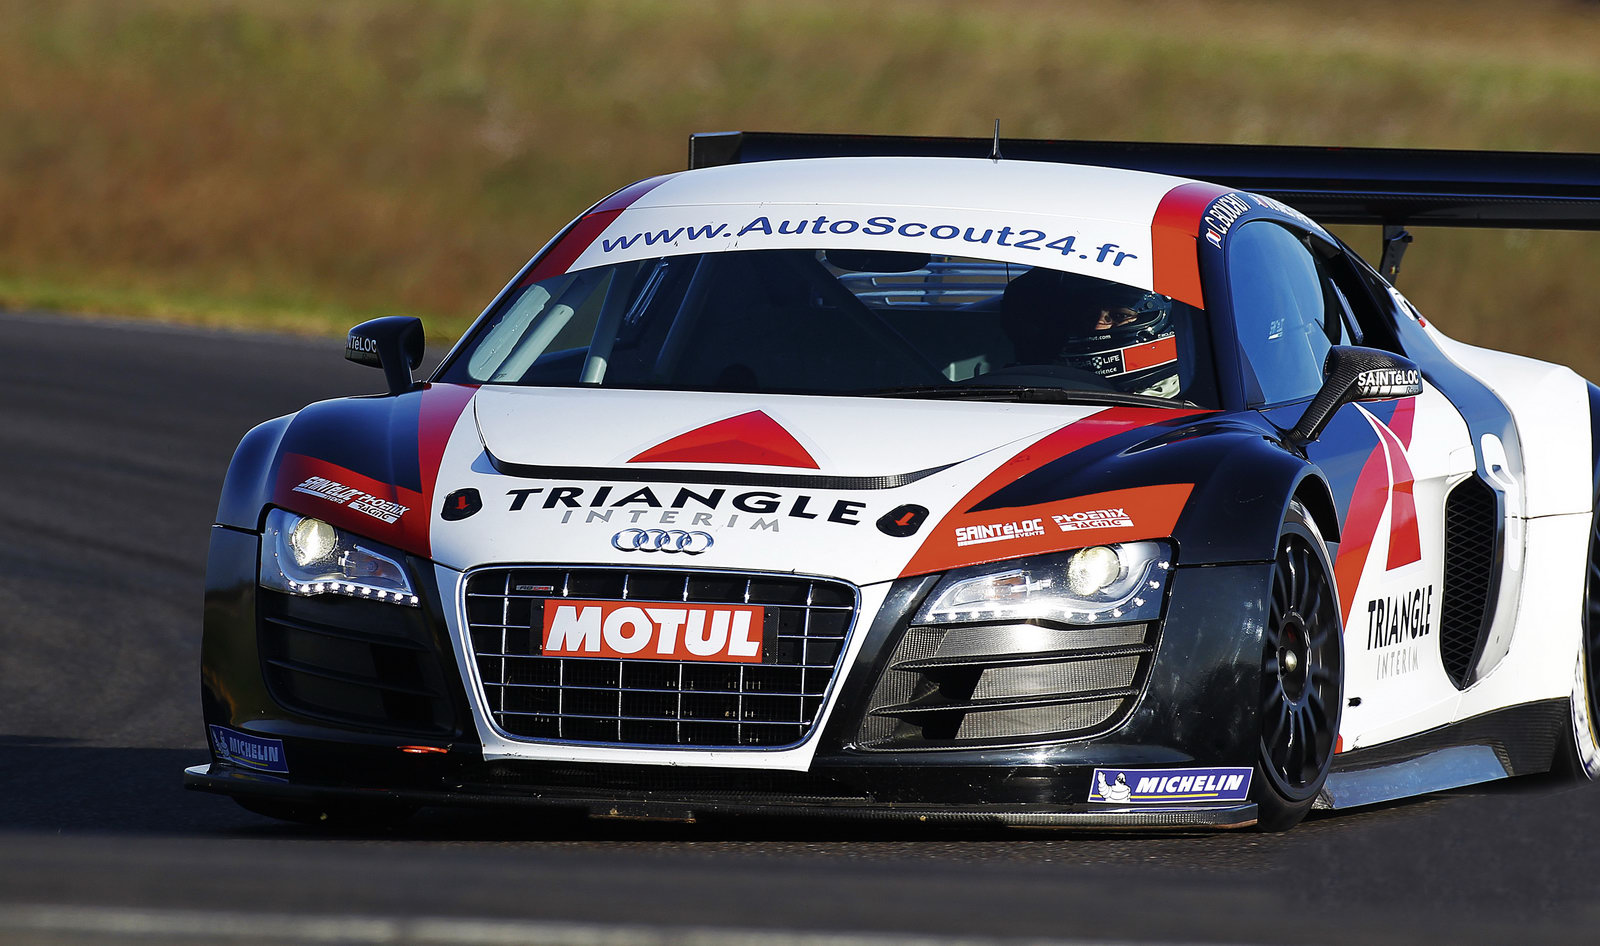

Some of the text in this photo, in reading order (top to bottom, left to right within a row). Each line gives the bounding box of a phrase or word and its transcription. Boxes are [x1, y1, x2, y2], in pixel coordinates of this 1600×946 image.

[602, 216, 1138, 268] www.AutoScout24.fr
[1102, 354, 1121, 365] LIFE
[1357, 369, 1419, 387] SAINTéLOC
[505, 485, 867, 526] TRIANGLE
[561, 509, 780, 533] INTERIM
[955, 518, 1044, 542] SAINTéLOC
[1014, 529, 1045, 539] EVENTS
[1367, 584, 1433, 651] TRIANGLE
[545, 605, 761, 657] MOTUL
[1376, 646, 1419, 680] INTERIM
[229, 736, 279, 762] MICHELIN
[1135, 774, 1245, 793] MICHELIN
